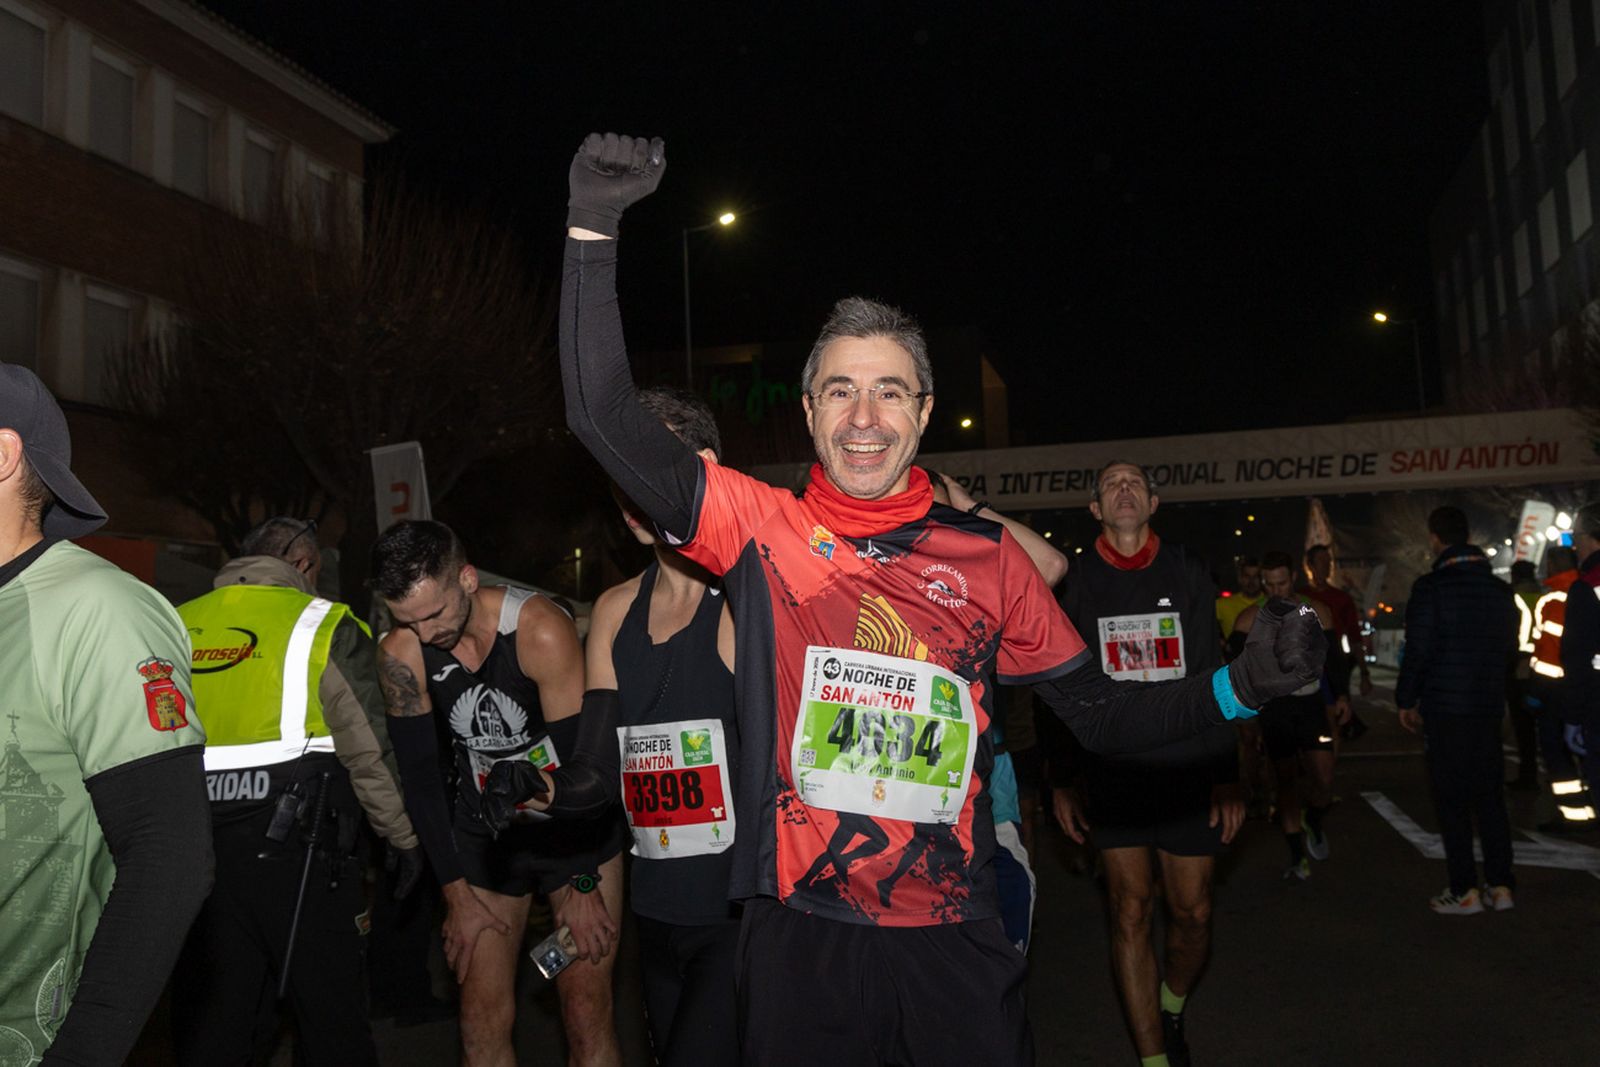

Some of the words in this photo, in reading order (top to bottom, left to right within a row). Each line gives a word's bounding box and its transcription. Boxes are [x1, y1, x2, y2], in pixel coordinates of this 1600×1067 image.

[998, 461, 1226, 496] INTERNONAL
[1236, 456, 1335, 482] NOCHE
[1341, 453, 1378, 477] DE
[1389, 448, 1451, 474] SAN
[1455, 436, 1560, 470] ANTÓN
[925, 589, 968, 609] Martos
[824, 662, 840, 674] 43
[842, 668, 894, 689] NOCHE
[896, 676, 917, 692] DE
[820, 685, 855, 704] SAN
[857, 690, 915, 712] ANTÓN
[660, 739, 672, 751] DE
[625, 757, 637, 771] SAN
[639, 752, 674, 770] ANTÓN
[875, 764, 915, 780] Antnio
[631, 771, 704, 813] 3398
